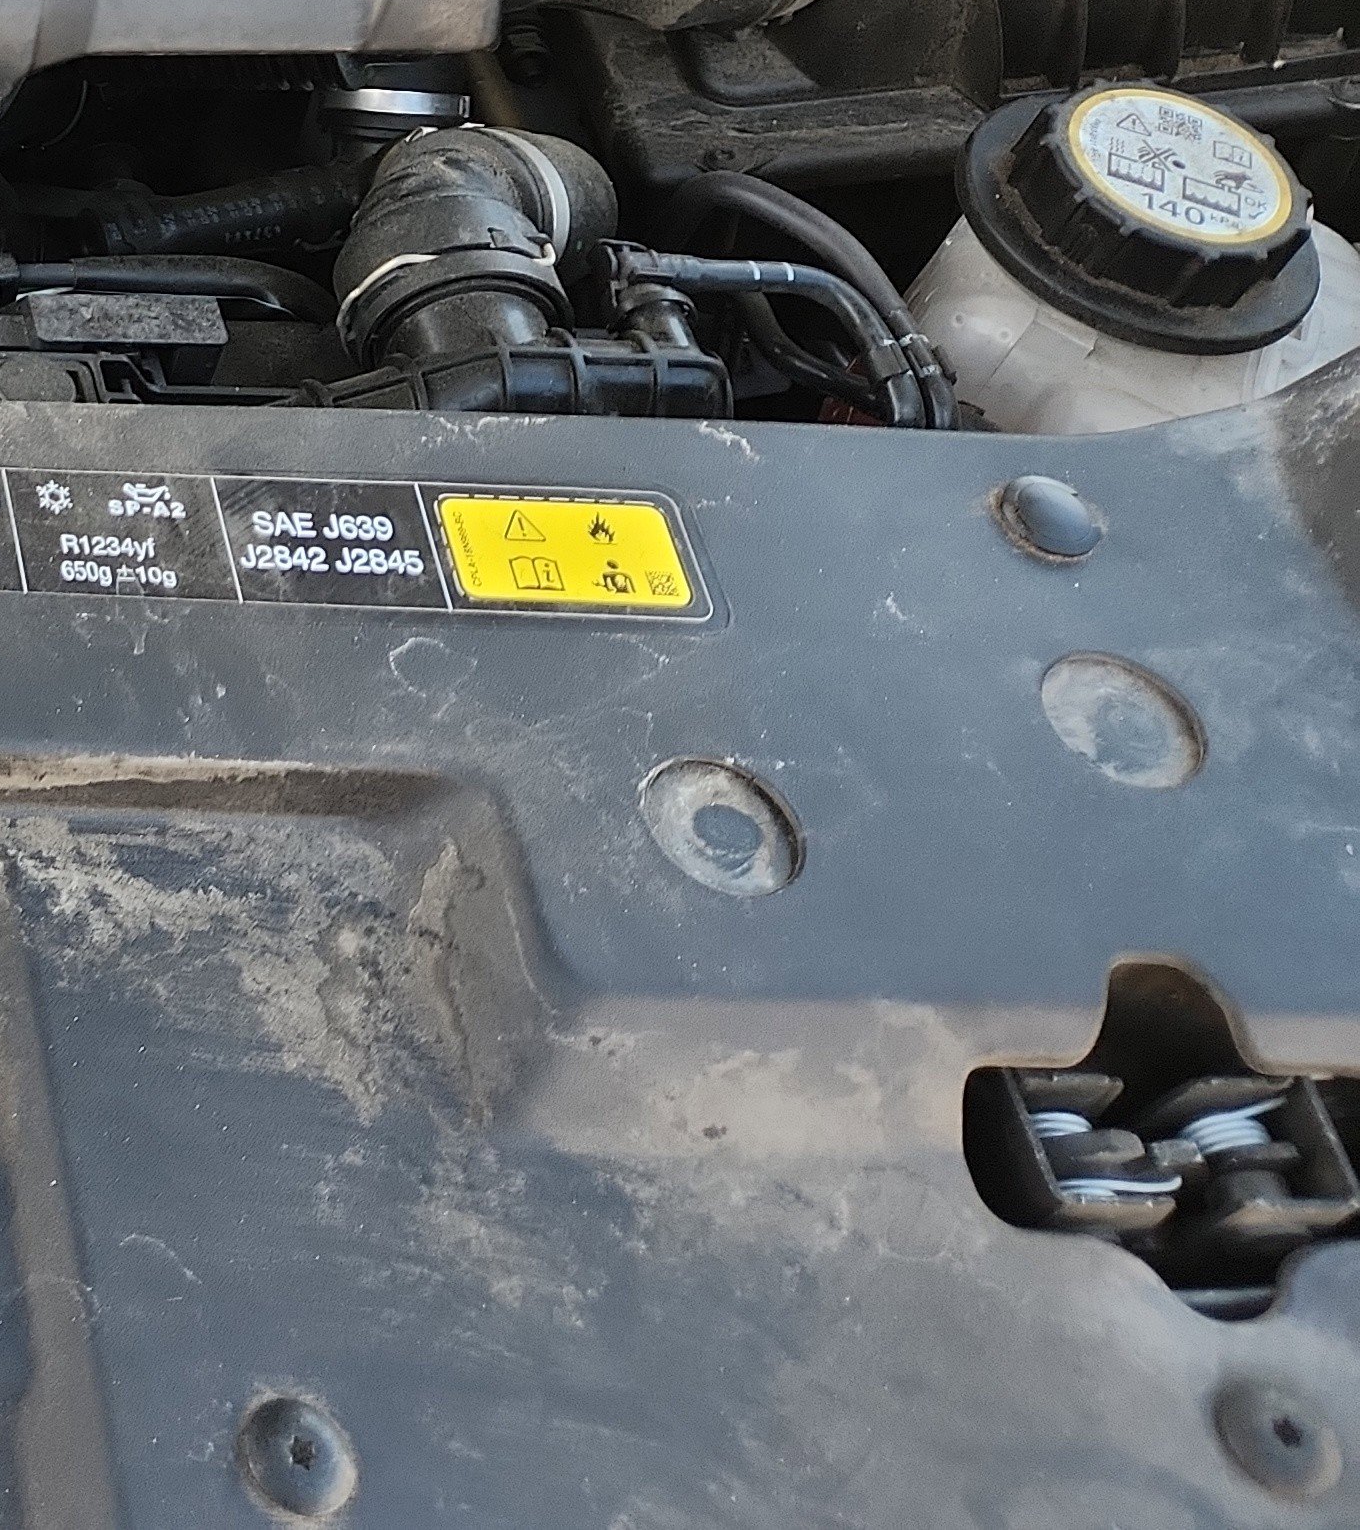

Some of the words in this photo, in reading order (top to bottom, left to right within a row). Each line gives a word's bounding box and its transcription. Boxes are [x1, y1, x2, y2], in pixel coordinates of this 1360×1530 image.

[1141, 192, 1206, 226] 140
[1244, 195, 1267, 212] OK
[107, 499, 187, 519] SP-A2
[252, 511, 317, 538] SAE
[322, 513, 394, 542] J639
[60, 533, 156, 563] R1234yf
[240, 543, 330, 572] J2842
[335, 547, 425, 576] J2845
[60, 559, 113, 587] 650g
